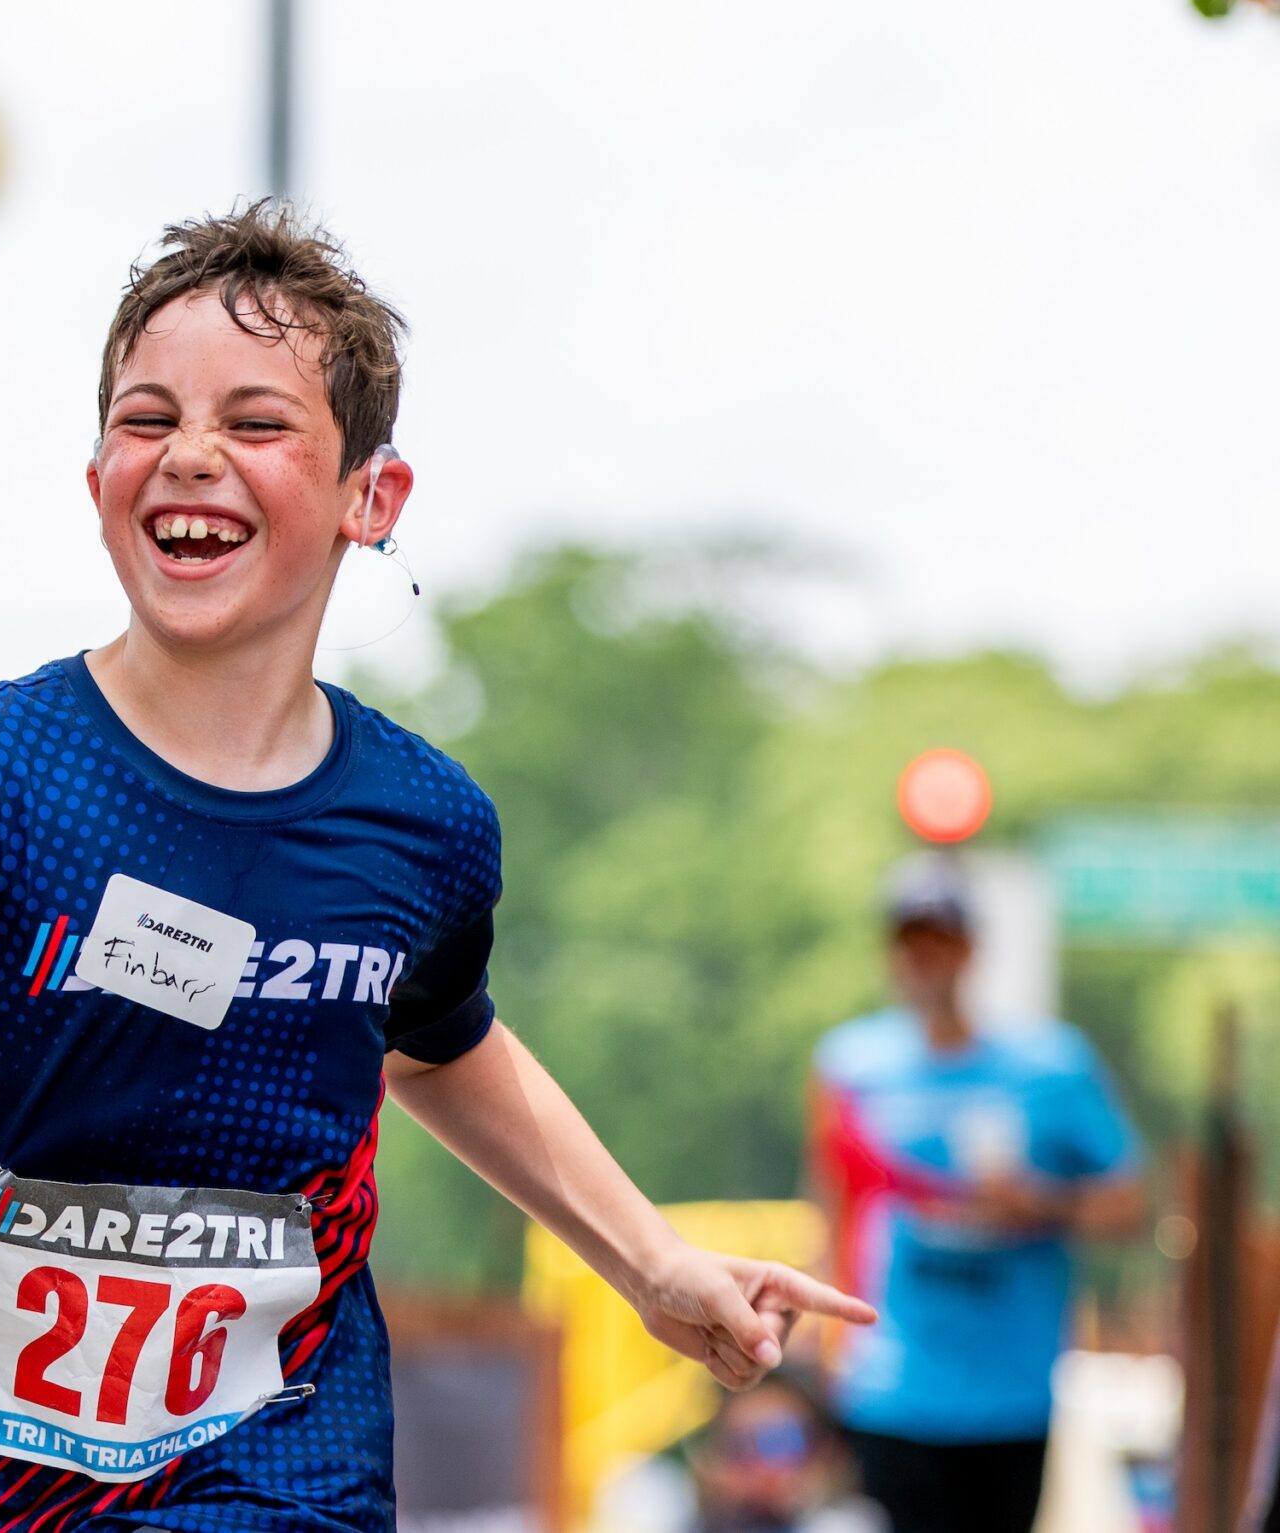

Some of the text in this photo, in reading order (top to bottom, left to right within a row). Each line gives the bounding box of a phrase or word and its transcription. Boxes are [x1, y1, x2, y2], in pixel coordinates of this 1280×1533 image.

[144, 918, 214, 953] DARE2TRI
[9, 1204, 286, 1261] DARE2TRI
[13, 1265, 247, 1426] 276
[3, 1418, 228, 1468] TRI IT TRIATHLON
